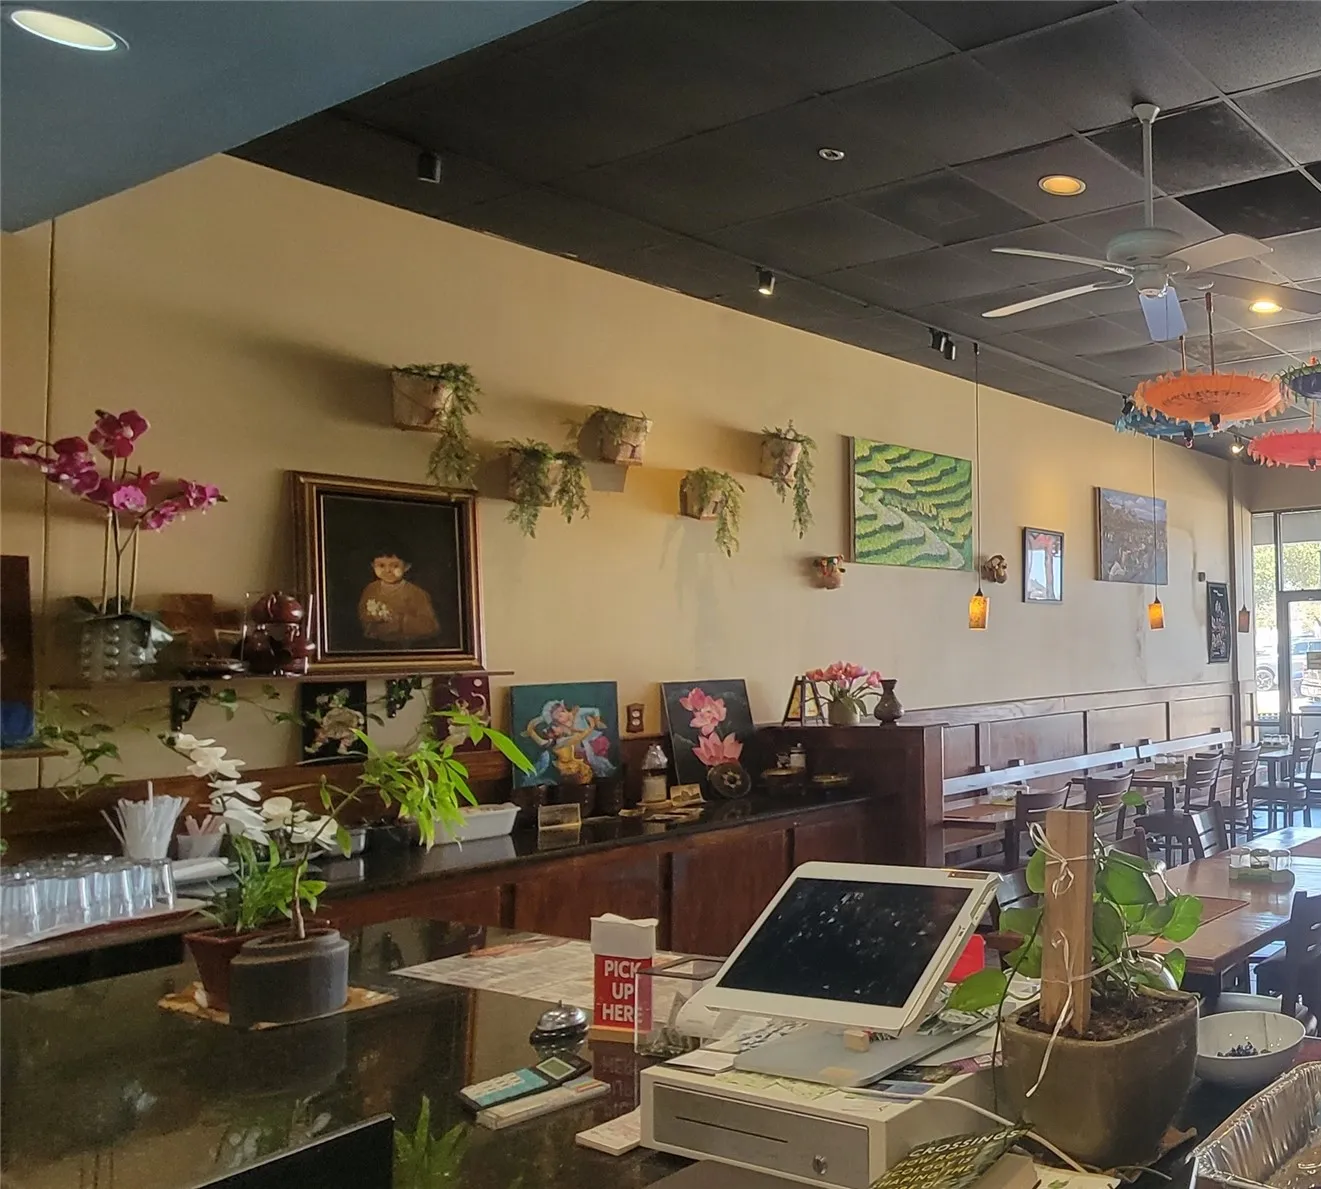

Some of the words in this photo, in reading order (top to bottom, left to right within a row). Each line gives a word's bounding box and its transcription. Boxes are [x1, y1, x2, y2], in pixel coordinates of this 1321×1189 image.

[604, 960, 641, 978] PICK
[612, 982, 634, 1000] UP
[602, 1003, 642, 1023] HERE
[909, 1129, 1019, 1158] CROSSINGS
[894, 1154, 935, 1169] HOW
[935, 1147, 978, 1162] ROAD
[958, 1156, 974, 1165] IS
[944, 1164, 974, 1176] THE
